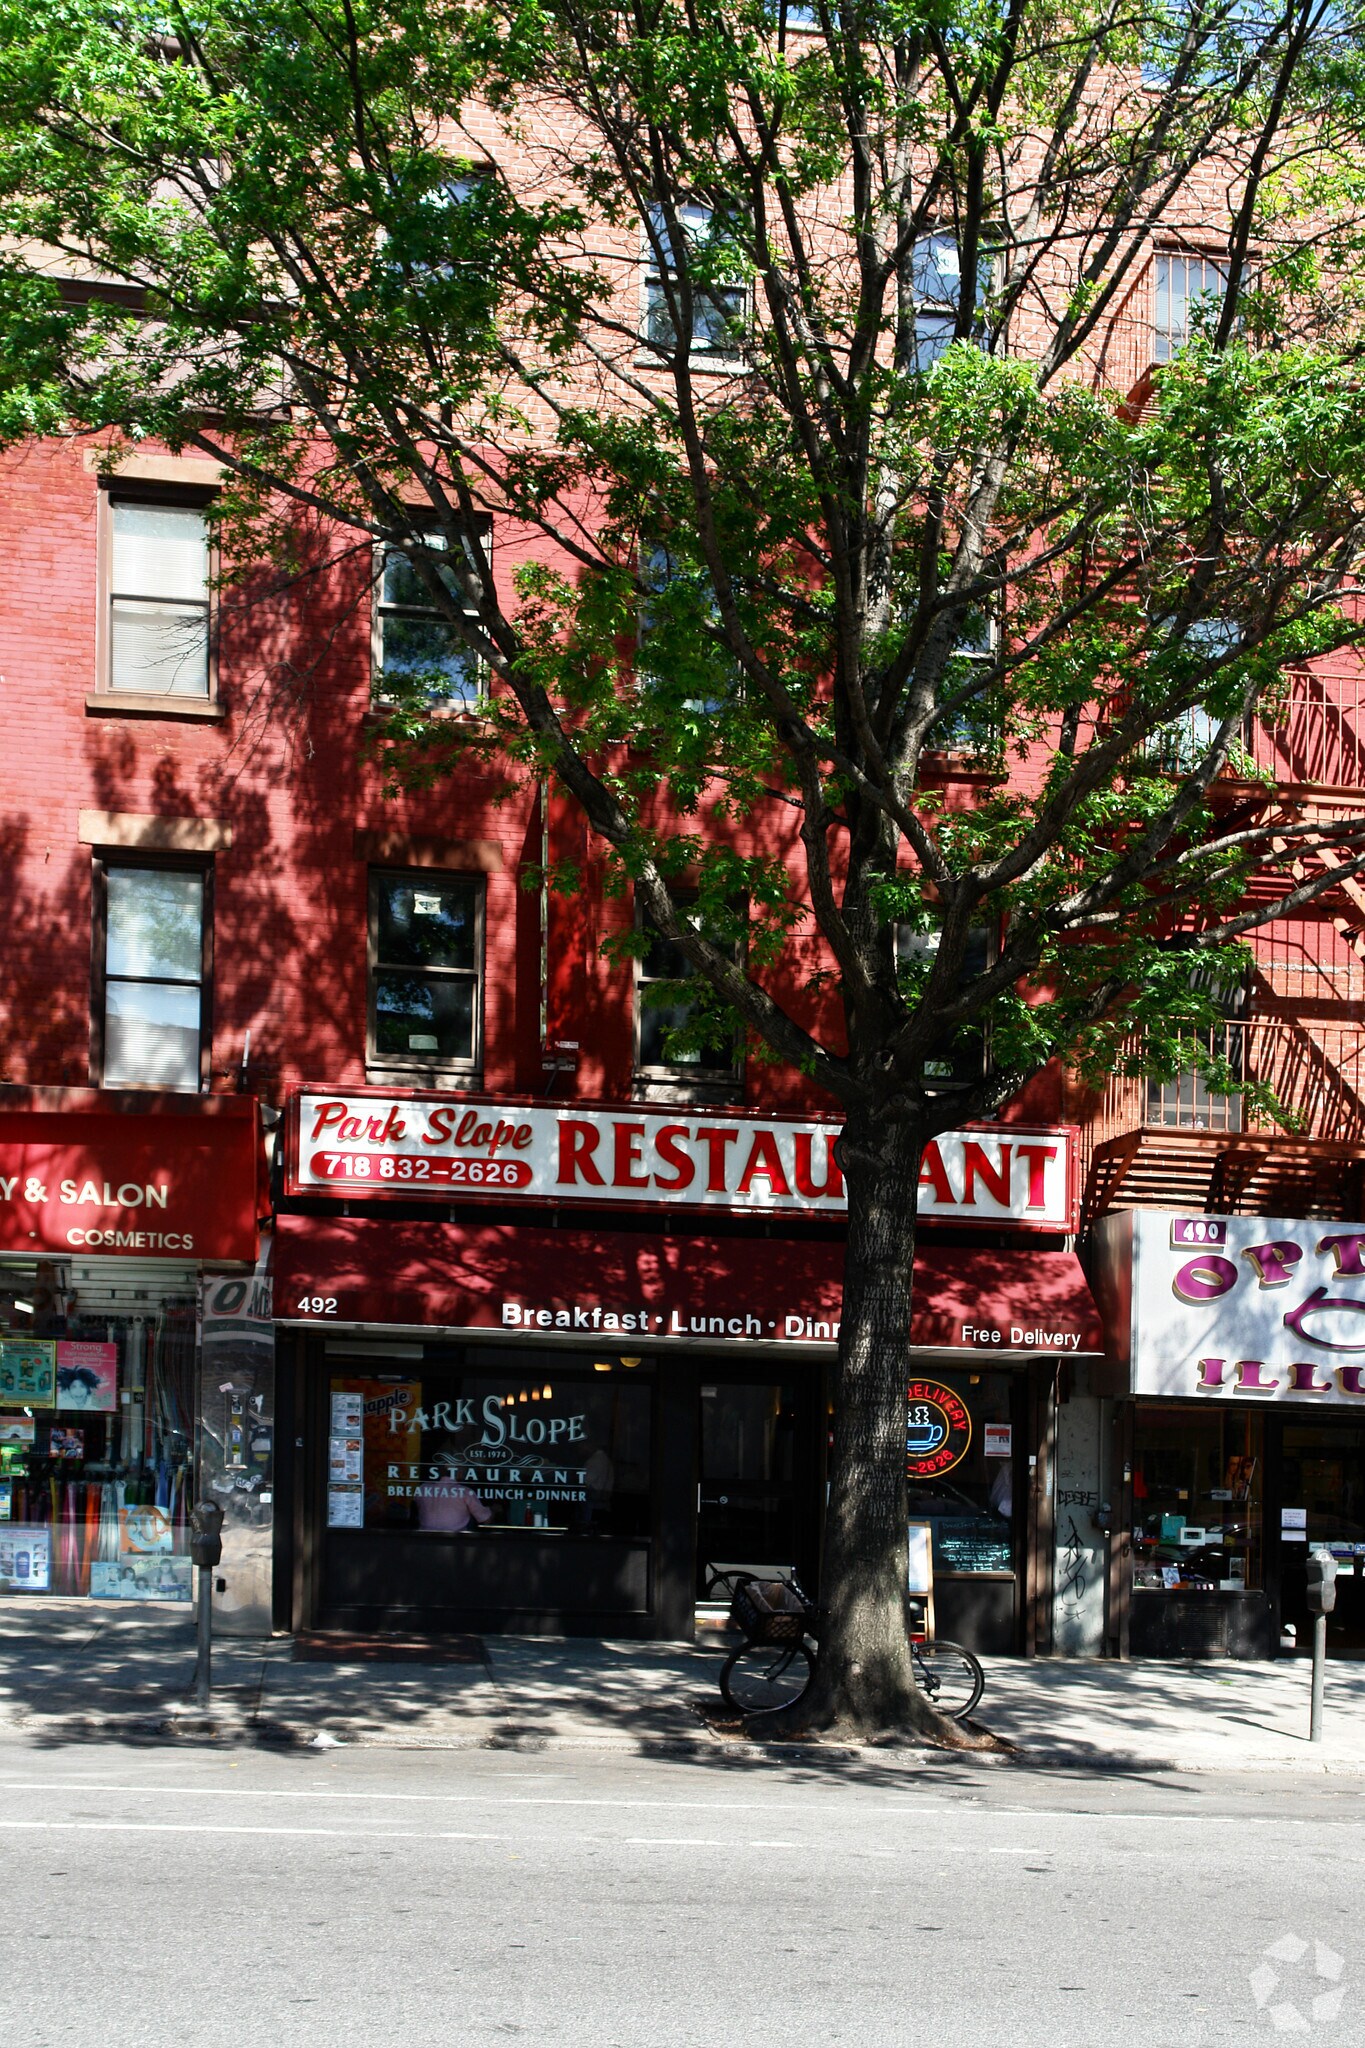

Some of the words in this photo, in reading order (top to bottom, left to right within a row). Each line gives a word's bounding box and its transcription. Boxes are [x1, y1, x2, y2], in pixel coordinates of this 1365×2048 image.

[310, 1102, 407, 1145] Park
[421, 1107, 533, 1157] Slope
[323, 1154, 371, 1177] 718
[379, 1156, 518, 1184] 832-2626
[556, 1119, 1058, 1212] RESTAUANT
[0, 1177, 19, 1201] Y
[59, 1179, 168, 1209] SALON
[66, 1227, 194, 1250] COSMETICS
[1182, 1223, 1220, 1242] 490
[297, 1296, 338, 1314] 492
[502, 1303, 648, 1331] Breakfast
[671, 1310, 761, 1335] Lunch
[962, 1325, 1001, 1343] Free
[1010, 1327, 1081, 1350] Delivery
[363, 1389, 408, 1415] apple
[388, 1398, 478, 1433] PARK
[480, 1395, 588, 1448] SLOPE
[387, 1465, 587, 1484] RESTAURANT
[387, 1485, 464, 1498] BREAKFAST
[477, 1488, 523, 1500] LUNCH
[536, 1489, 587, 1501] DINNER
